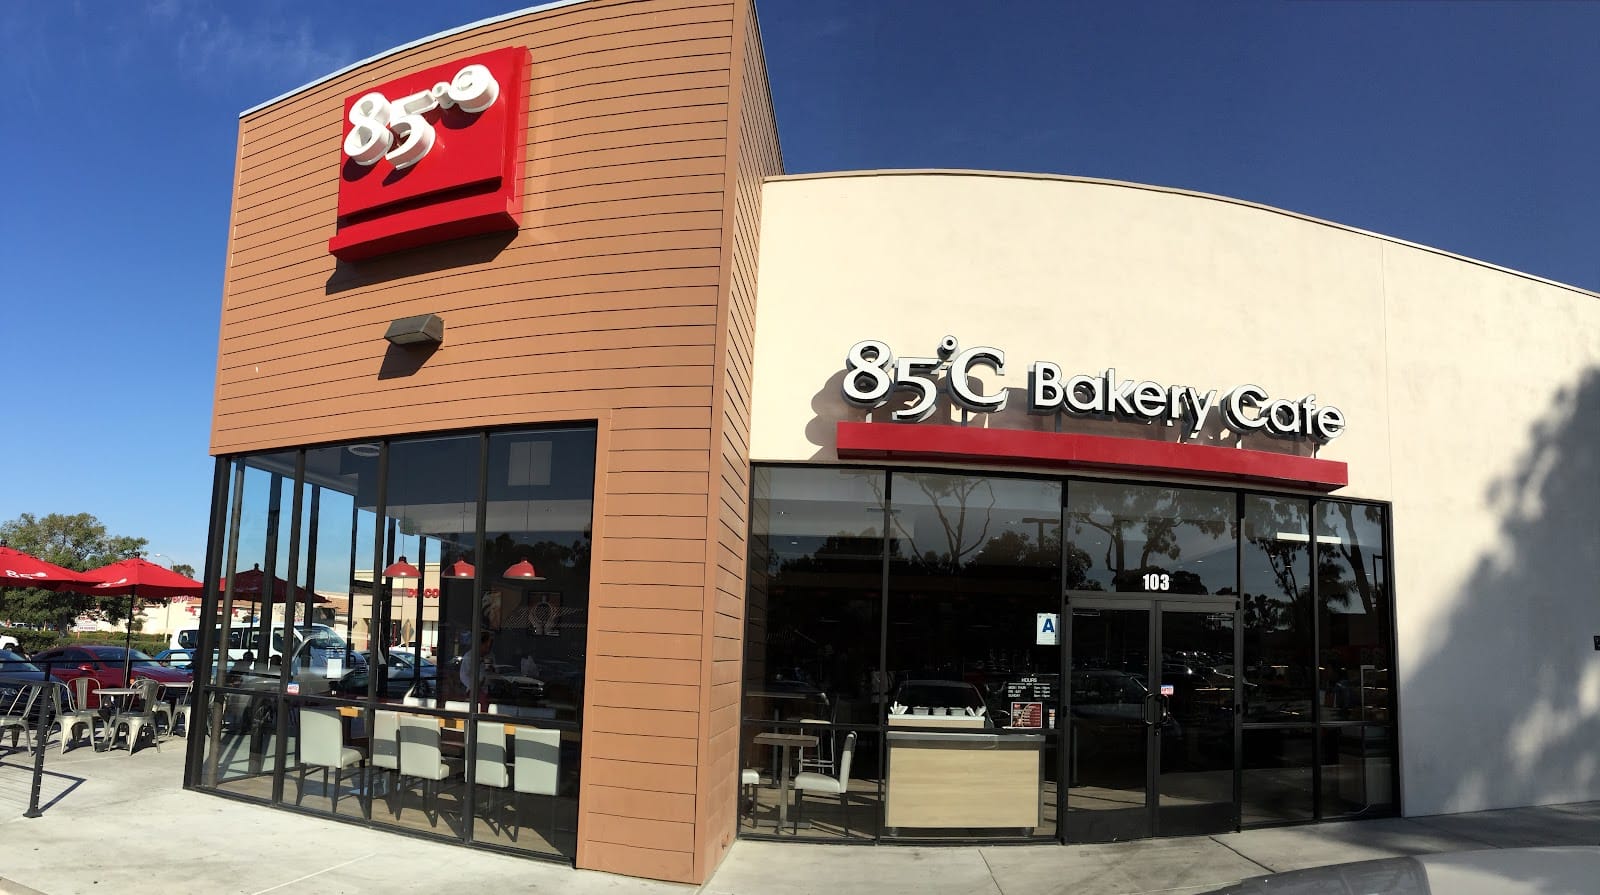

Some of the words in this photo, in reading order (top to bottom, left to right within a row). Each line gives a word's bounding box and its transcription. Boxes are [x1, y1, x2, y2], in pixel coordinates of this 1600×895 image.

[842, 335, 1009, 422] 85°C
[1029, 361, 1217, 436] Bakery
[1220, 384, 1346, 443] Cafe
[1142, 573, 1170, 591] 103
[1042, 618, 1055, 633] A
